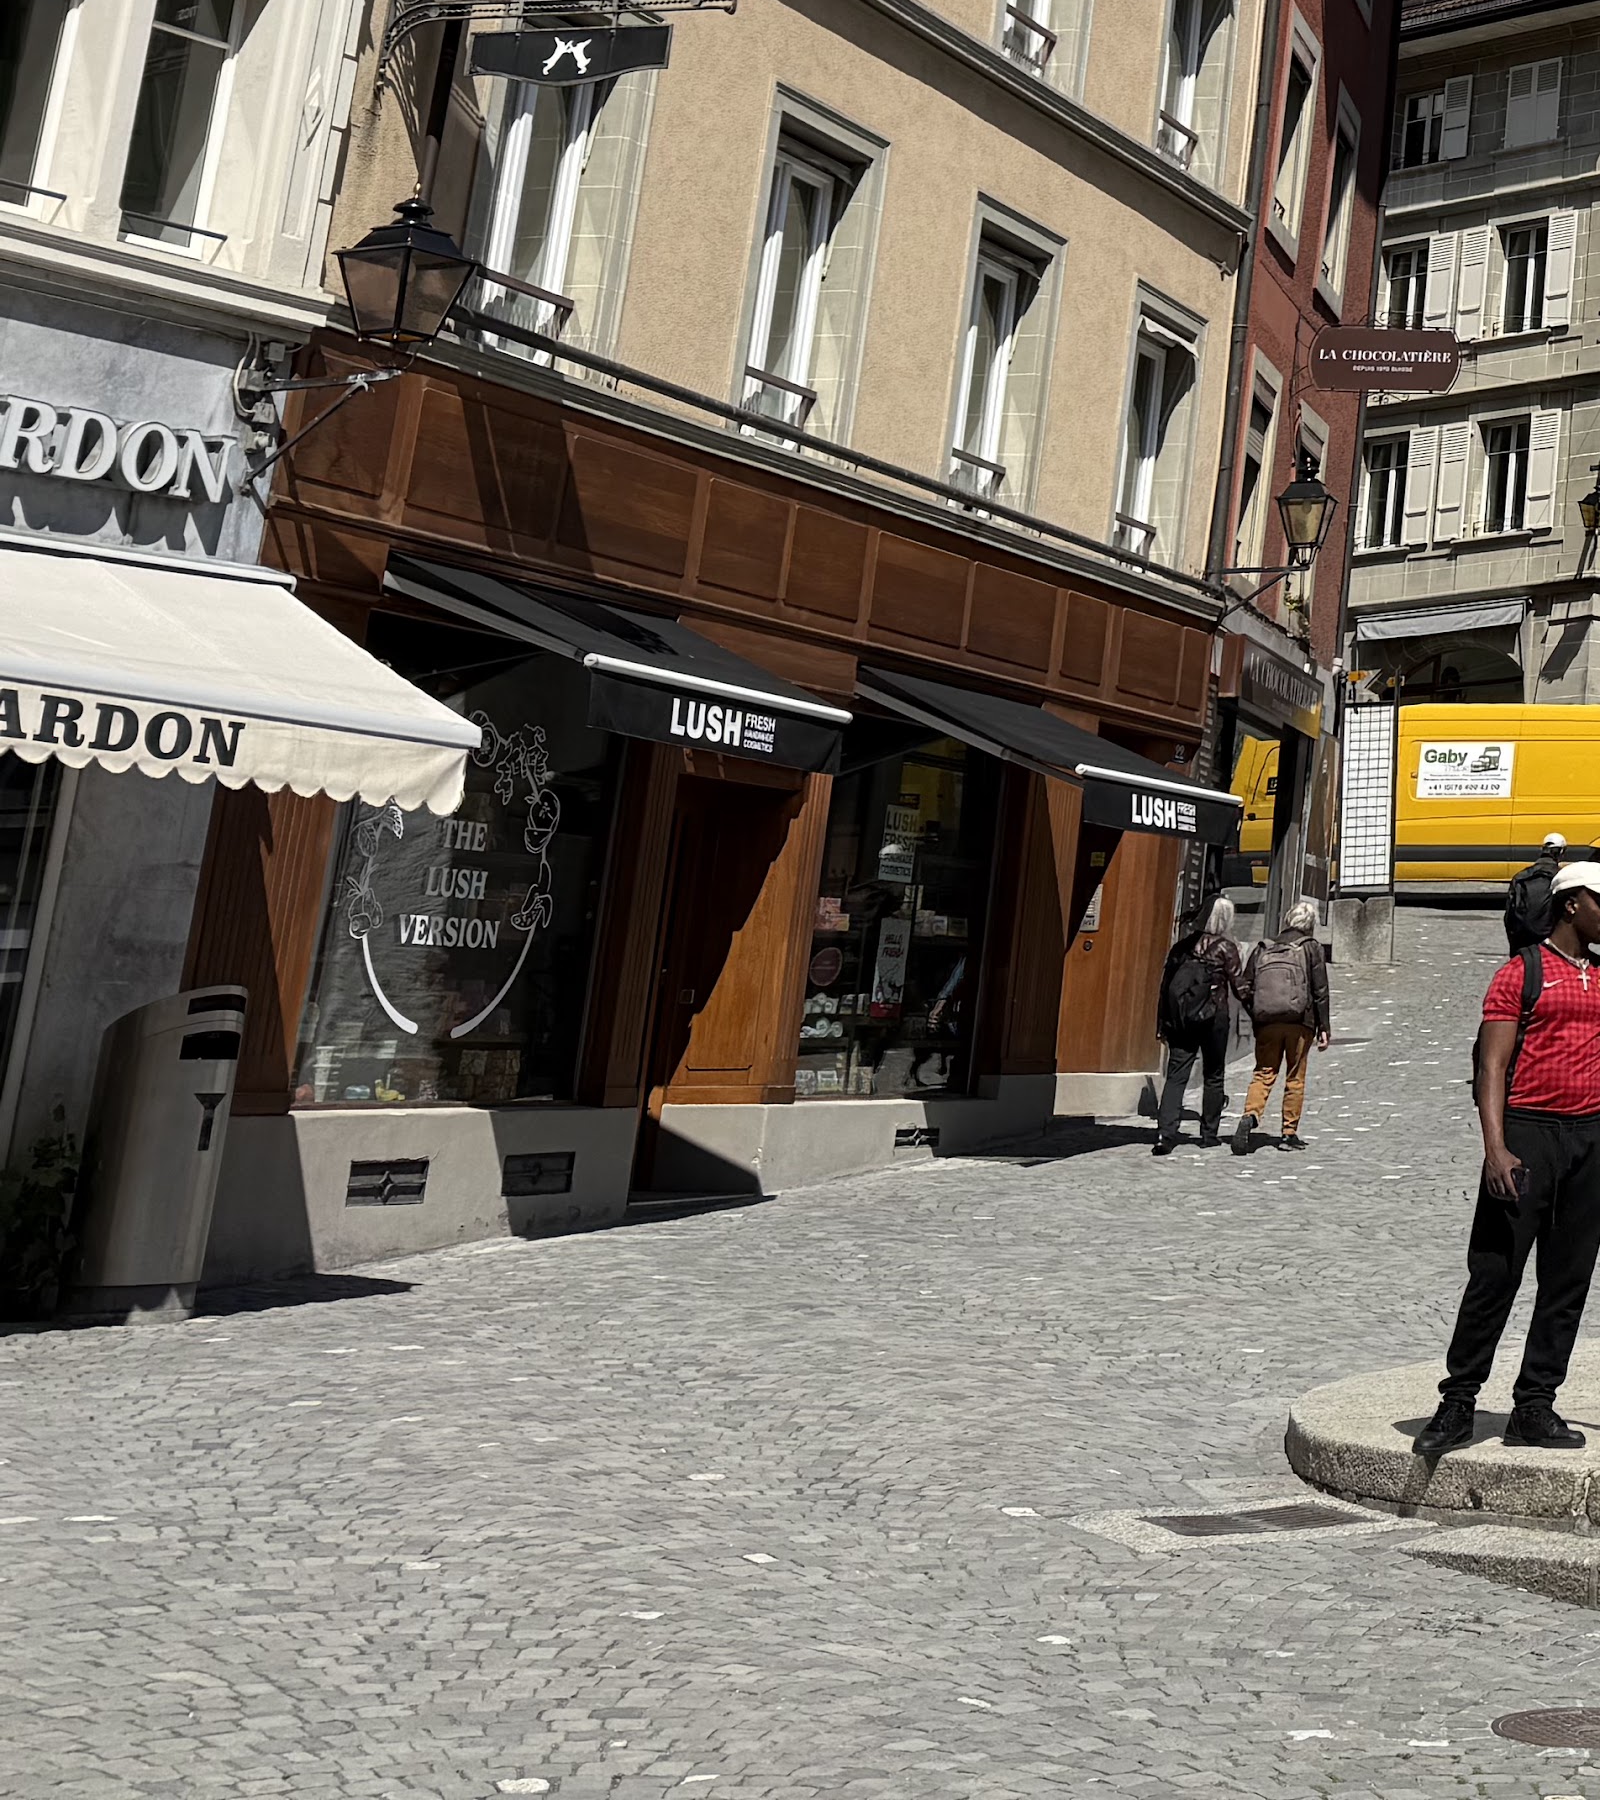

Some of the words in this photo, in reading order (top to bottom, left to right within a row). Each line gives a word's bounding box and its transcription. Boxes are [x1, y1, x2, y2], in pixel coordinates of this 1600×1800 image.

[1319, 348, 1337, 360] LA
[1342, 349, 1452, 363] CHOCOLATIÈRE
[670, 697, 742, 747] LUSH
[745, 713, 776, 732] FRESH
[1424, 748, 1468, 767] Gaby
[886, 811, 918, 833] LUSH
[1131, 793, 1177, 830] LUSH
[443, 819, 488, 852] THE
[425, 866, 488, 900] LUSH
[399, 913, 500, 949] VERSION
